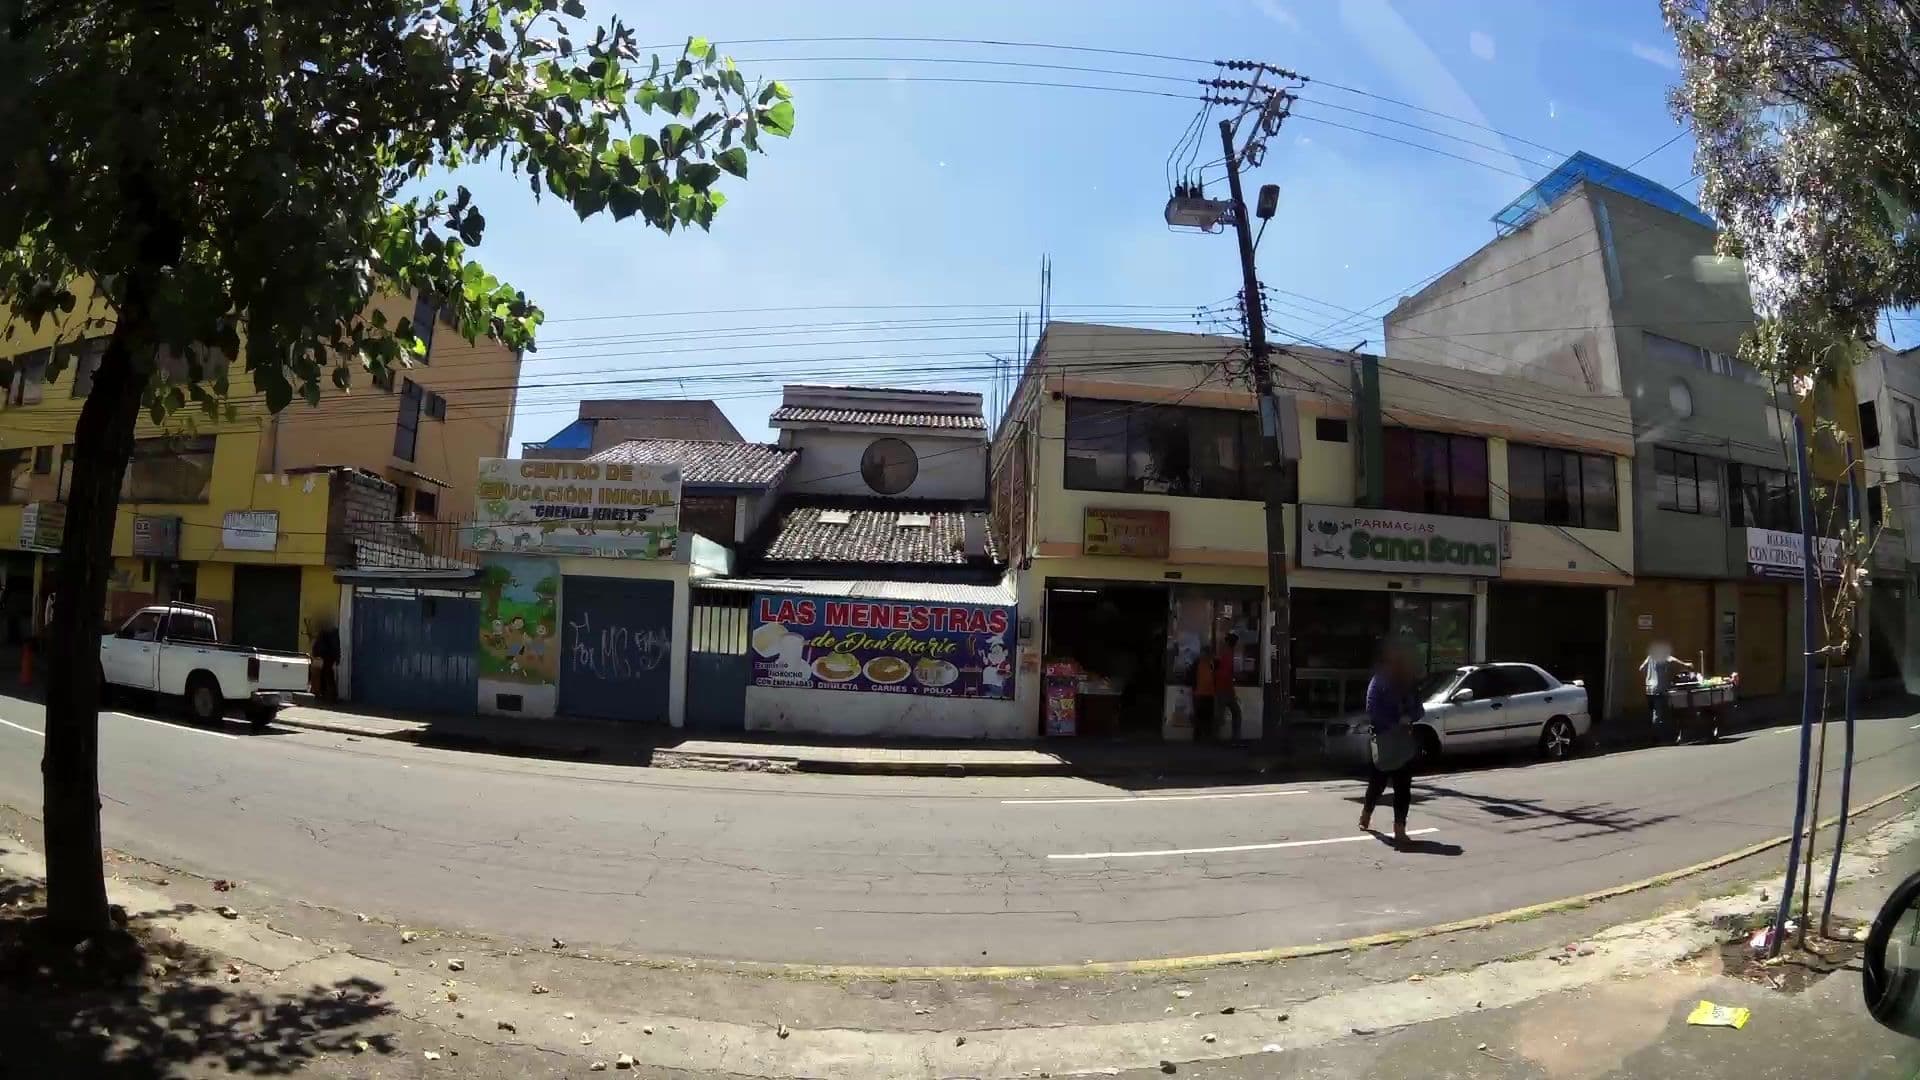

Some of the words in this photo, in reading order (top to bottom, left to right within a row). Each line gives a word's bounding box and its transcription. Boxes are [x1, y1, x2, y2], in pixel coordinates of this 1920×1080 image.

[520, 462, 600, 480] CENTRO
[605, 463, 633, 481] DE
[598, 487, 674, 506] INICIAL
[1353, 517, 1436, 534] FARMACIAS
[1349, 529, 1426, 562] Sana
[1427, 535, 1497, 566] Sana
[1748, 545, 1768, 562] CON
[1768, 547, 1800, 566] CRISTO
[760, 597, 817, 626] LAS
[824, 601, 1008, 635] MENESTRAS
[810, 630, 836, 648] de
[834, 631, 888, 655] Don
[871, 684, 908, 694] CARNES
[912, 686, 919, 694] Y
[923, 686, 953, 695] POLLO
